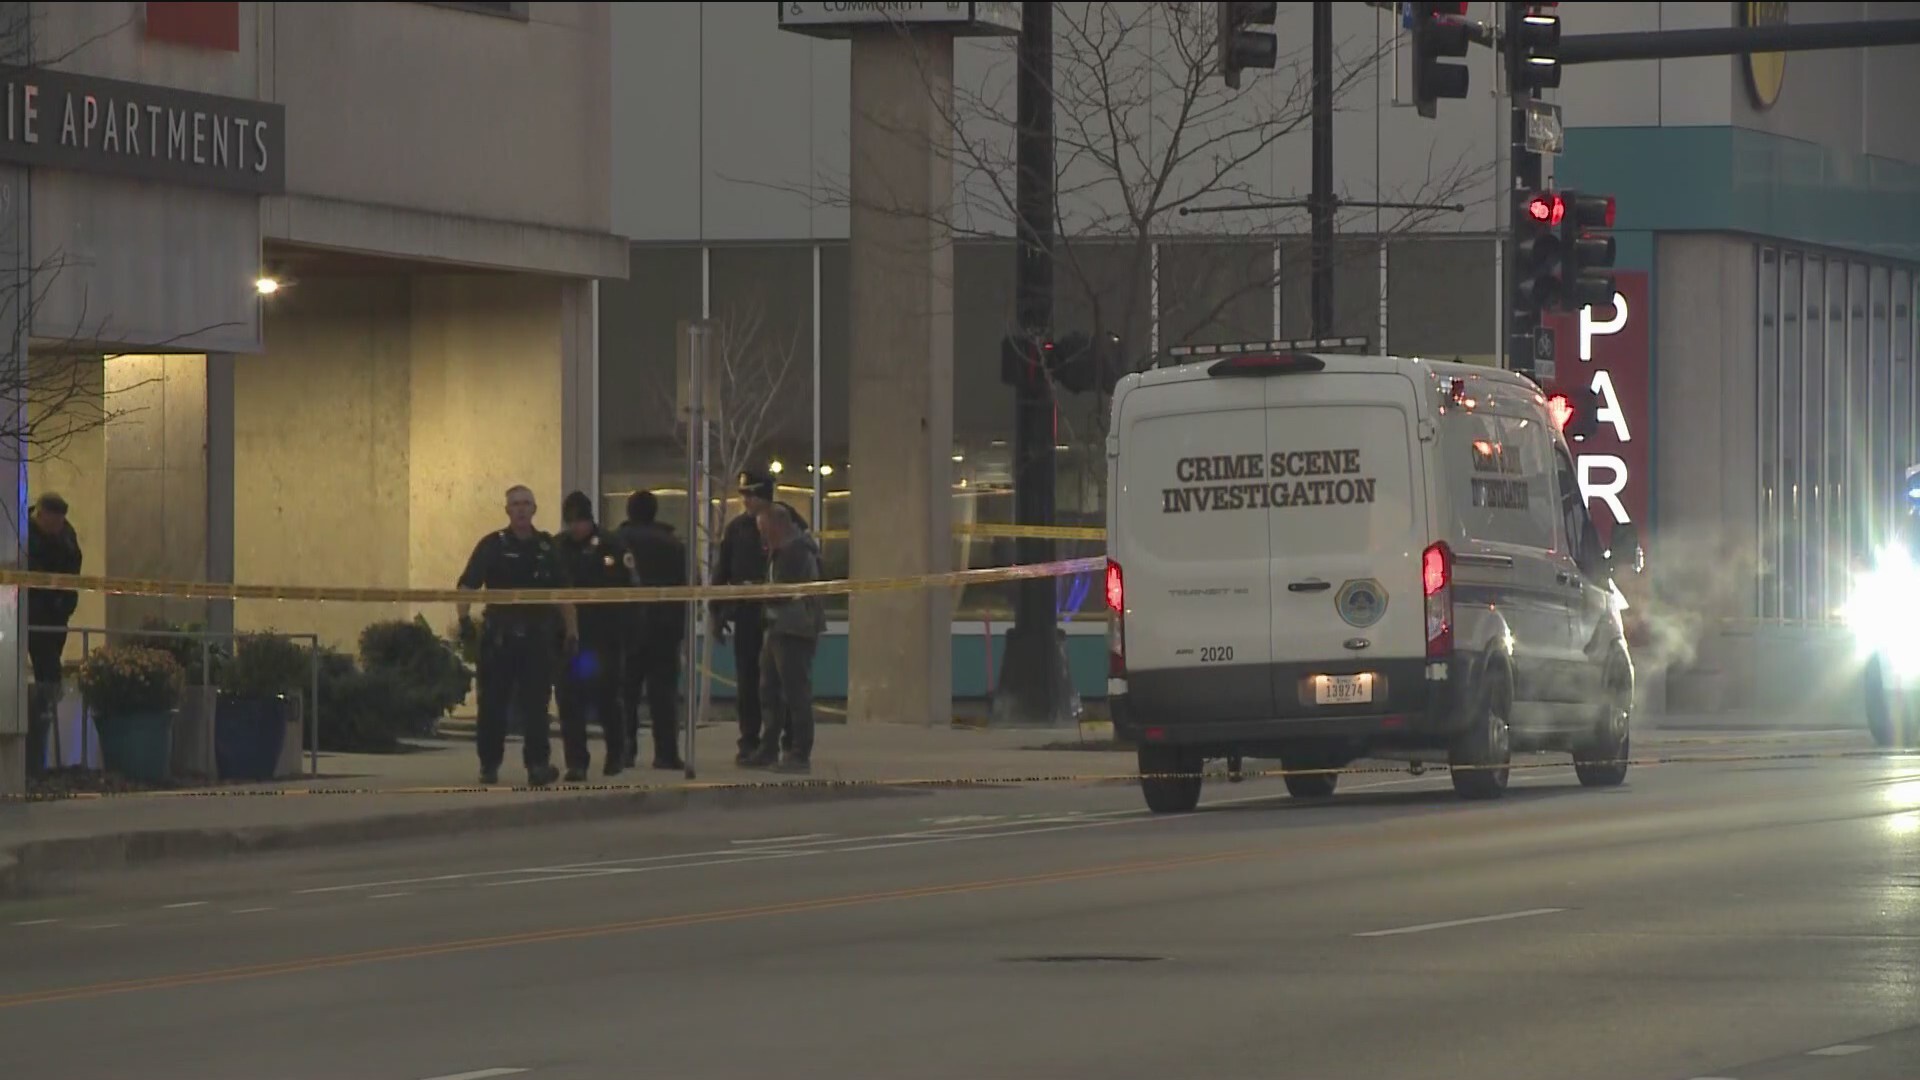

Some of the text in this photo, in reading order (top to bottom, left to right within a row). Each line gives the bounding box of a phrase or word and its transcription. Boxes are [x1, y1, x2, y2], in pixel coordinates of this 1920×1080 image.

[7, 82, 268, 172] IE APARTMENTS
[1177, 449, 1360, 482] CRIME SCENE
[1162, 478, 1376, 513] INVESTIGATION
[1200, 646, 1234, 662] 2020
